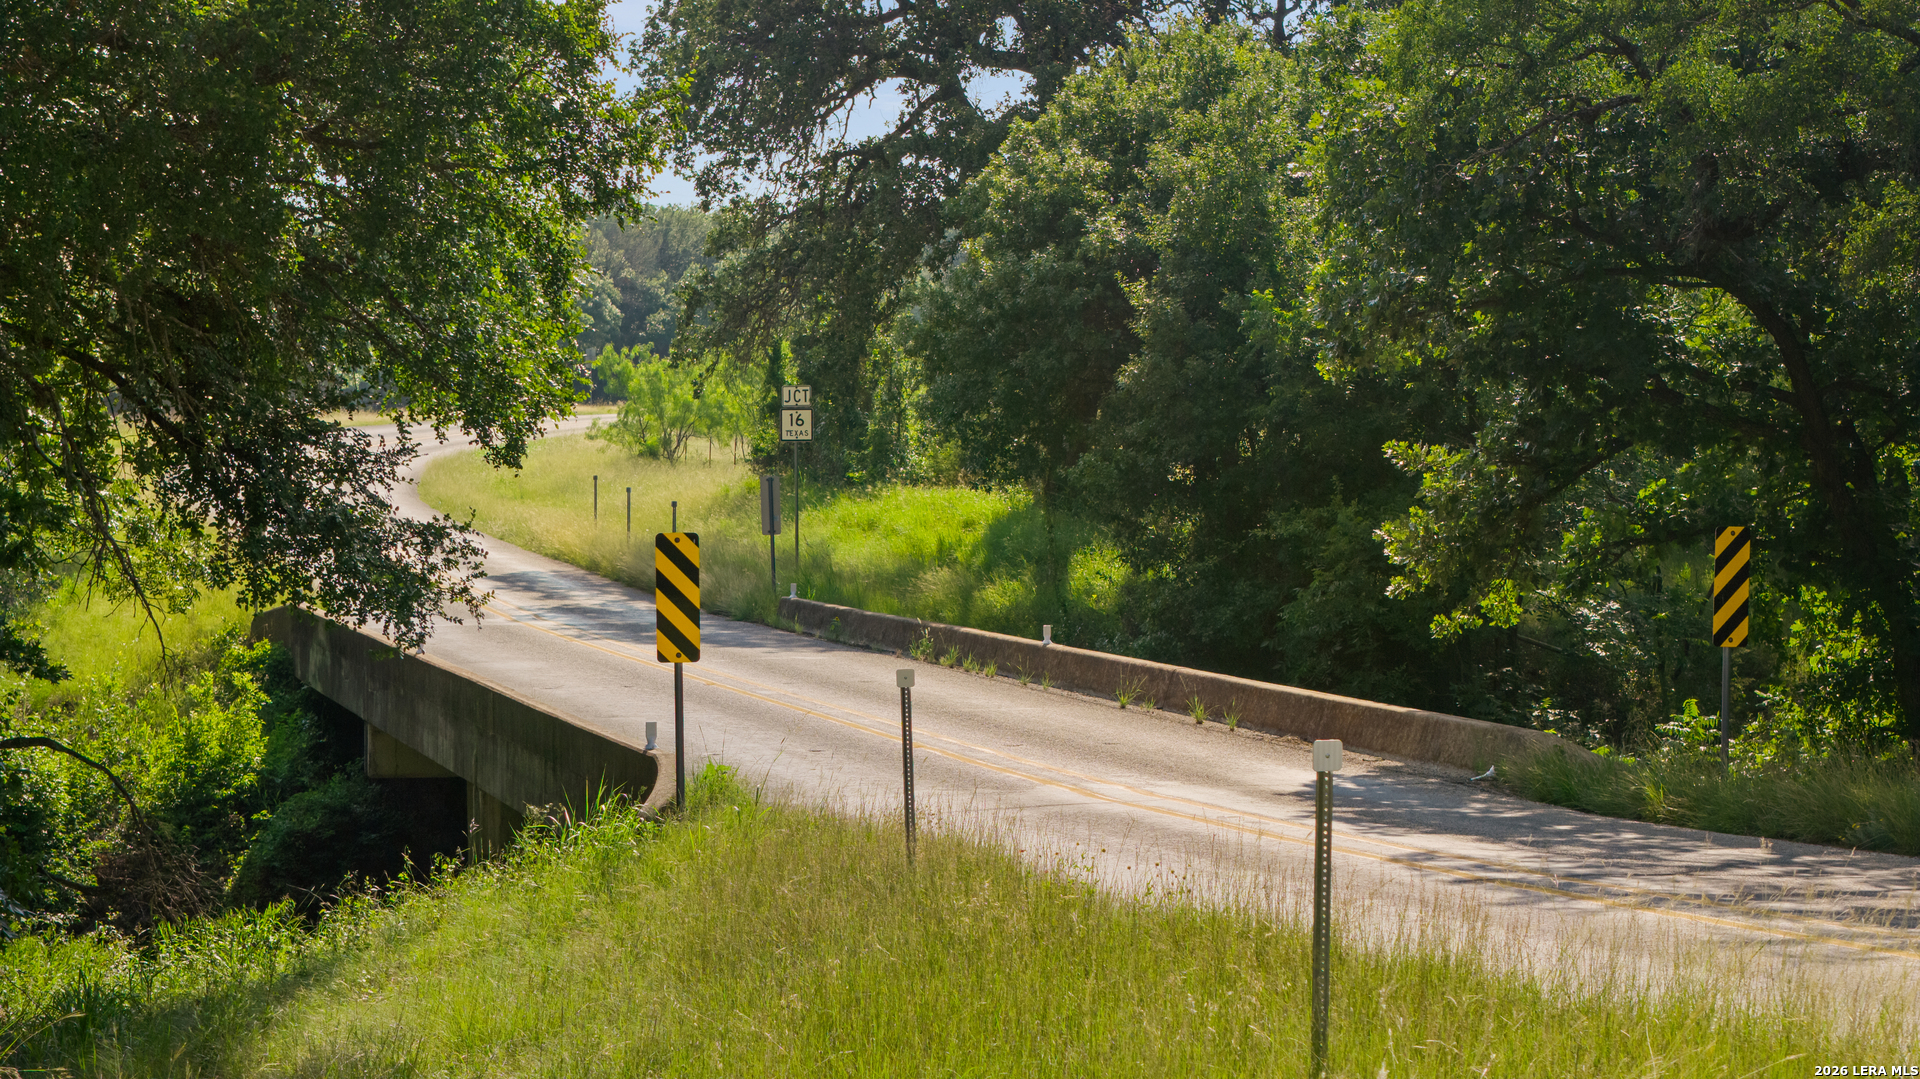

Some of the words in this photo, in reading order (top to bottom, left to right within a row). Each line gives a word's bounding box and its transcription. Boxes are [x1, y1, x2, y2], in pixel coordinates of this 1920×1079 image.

[784, 389, 809, 403] JCT
[789, 413, 805, 427] 16
[785, 429, 809, 437] TEXAS
